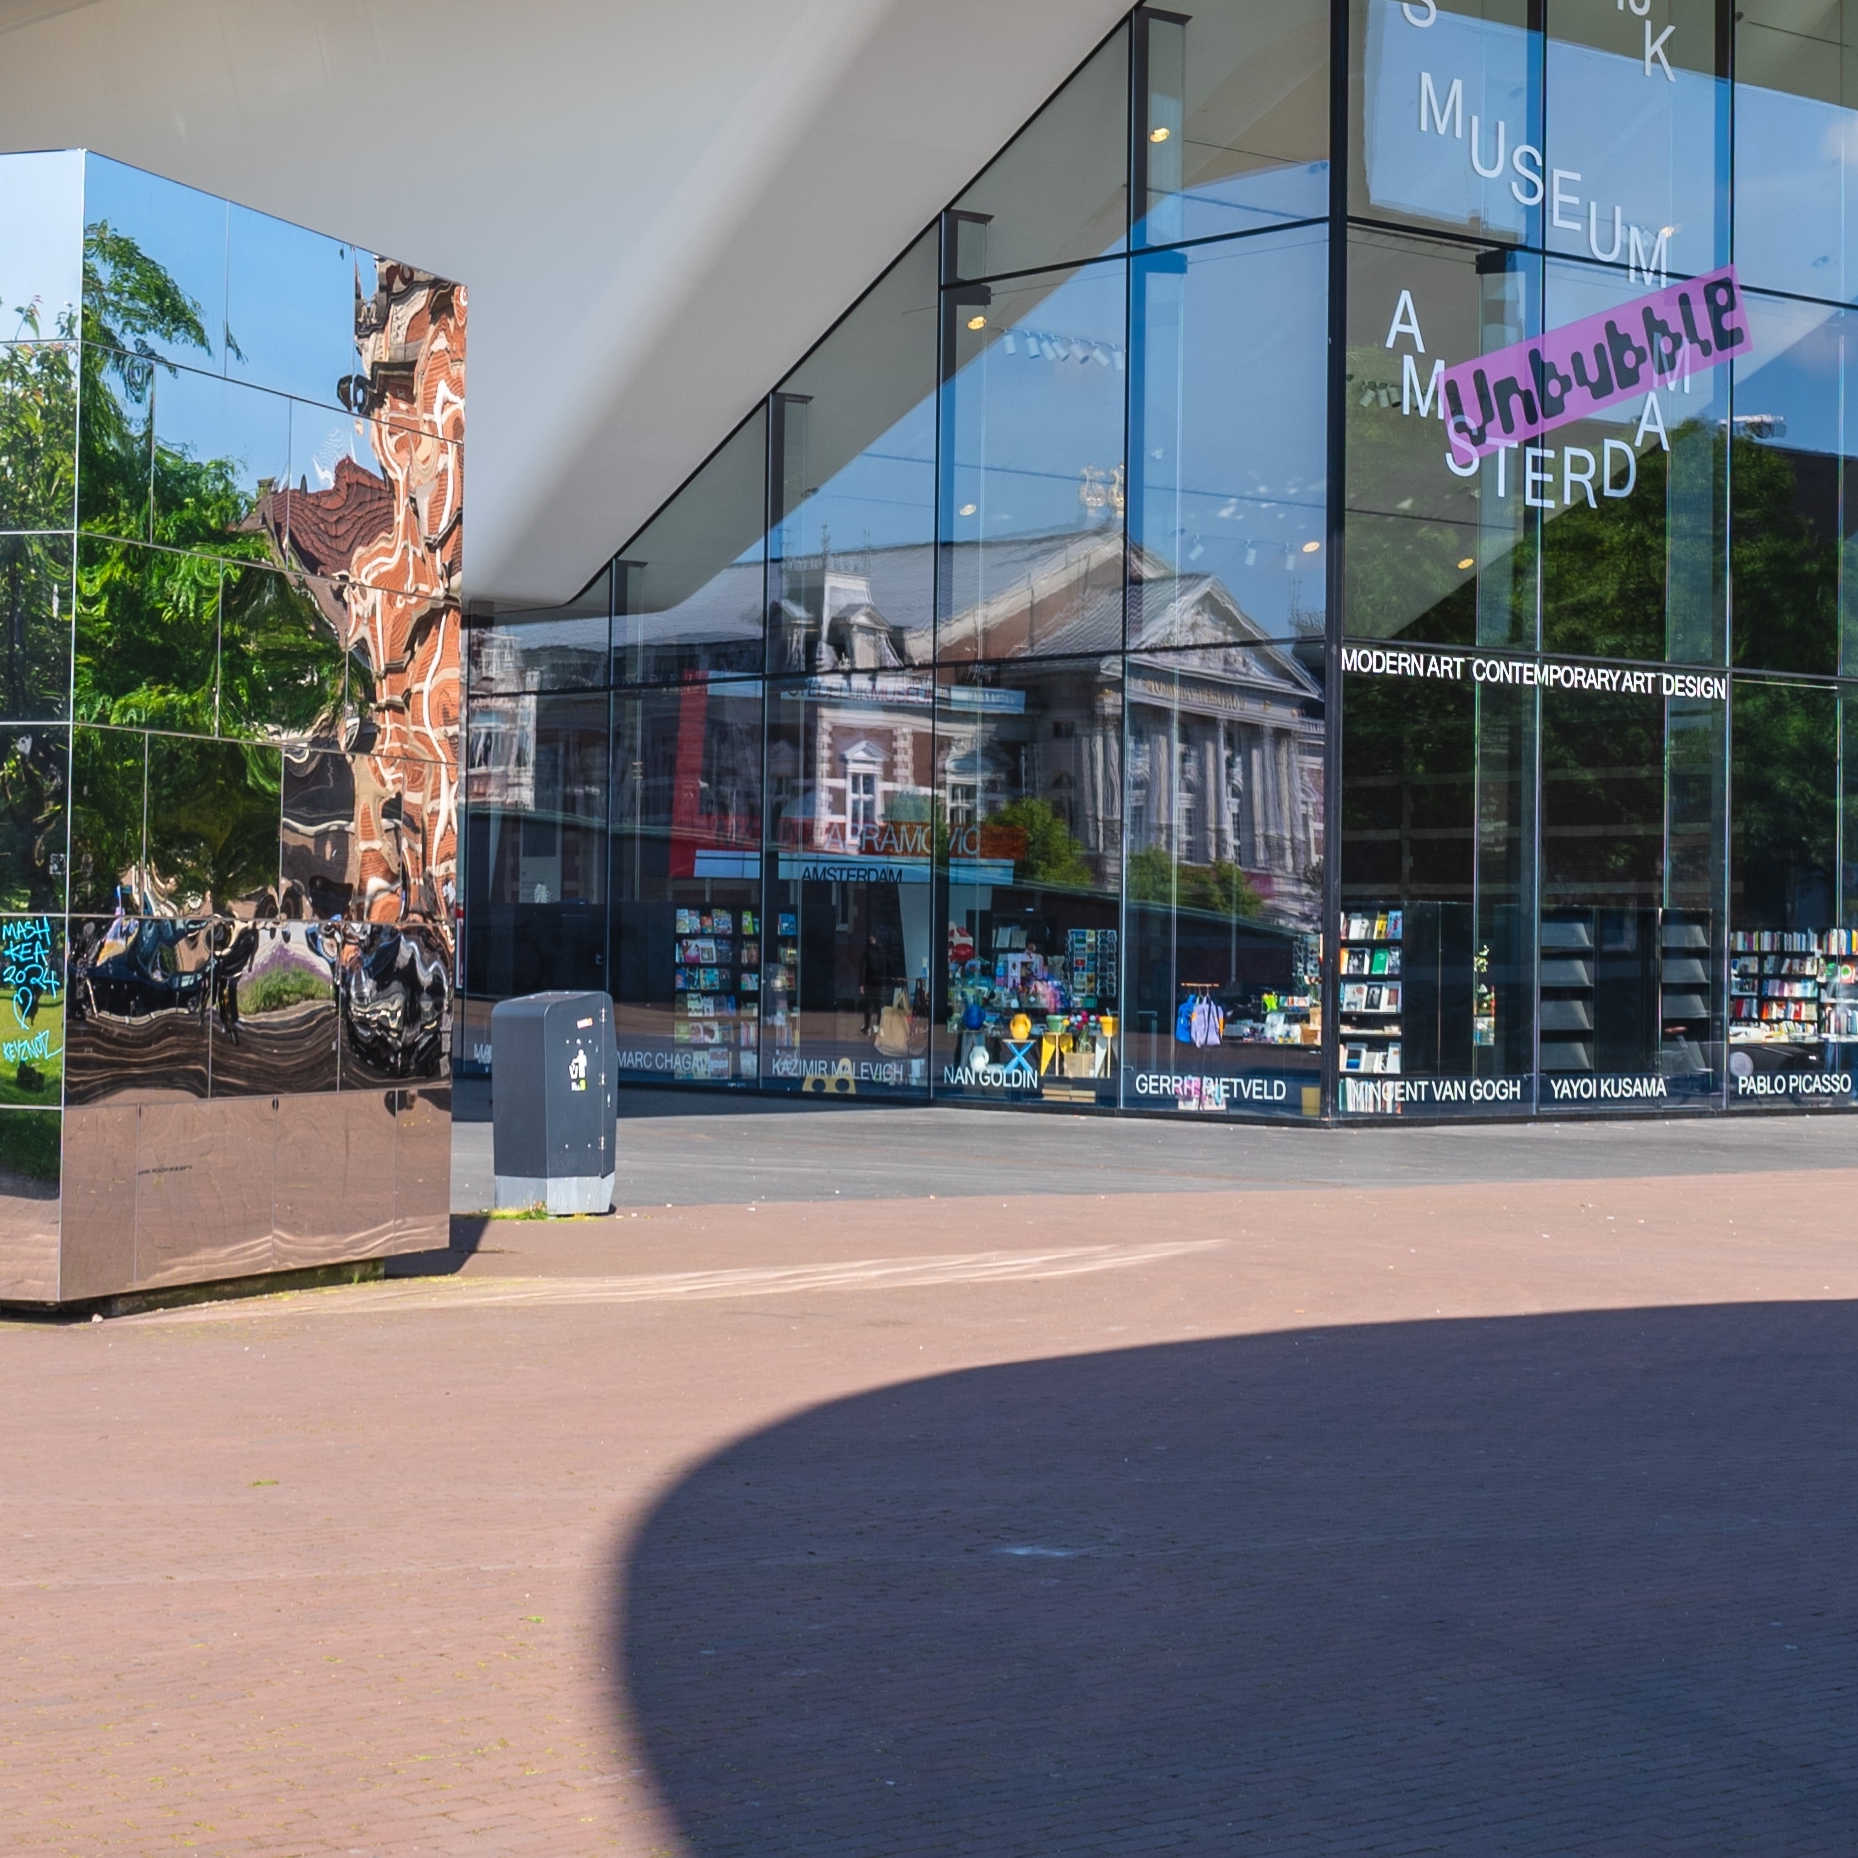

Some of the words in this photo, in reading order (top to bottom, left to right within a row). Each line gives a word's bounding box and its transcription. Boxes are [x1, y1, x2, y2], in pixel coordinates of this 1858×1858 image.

[1419, 72, 1668, 289] MUSEUM
[1385, 289, 1690, 509] AMSTERDAM
[1341, 647, 1425, 678] MODERN
[1427, 655, 1466, 680] ART
[1472, 658, 1620, 693] CONTEMPORARY
[1621, 671, 1657, 695] ART
[1662, 673, 1726, 701] DESIGN
[3, 963, 60, 999] 2024
[772, 1058, 828, 1077] KAZIMIR
[831, 1061, 903, 1082] MALEVICH
[943, 1066, 973, 1085] NAN
[978, 1068, 1039, 1089] GOLDIN
[1203, 1076, 1287, 1101] RIETVELD
[1432, 1080, 1467, 1102] VAN
[1470, 1079, 1521, 1102] GOGH
[1551, 1078, 1597, 1099] YAYOI
[1600, 1077, 1667, 1099] KUSAMA
[1738, 1074, 1787, 1095] PABLO
[1788, 1073, 1852, 1095] PICASSO
